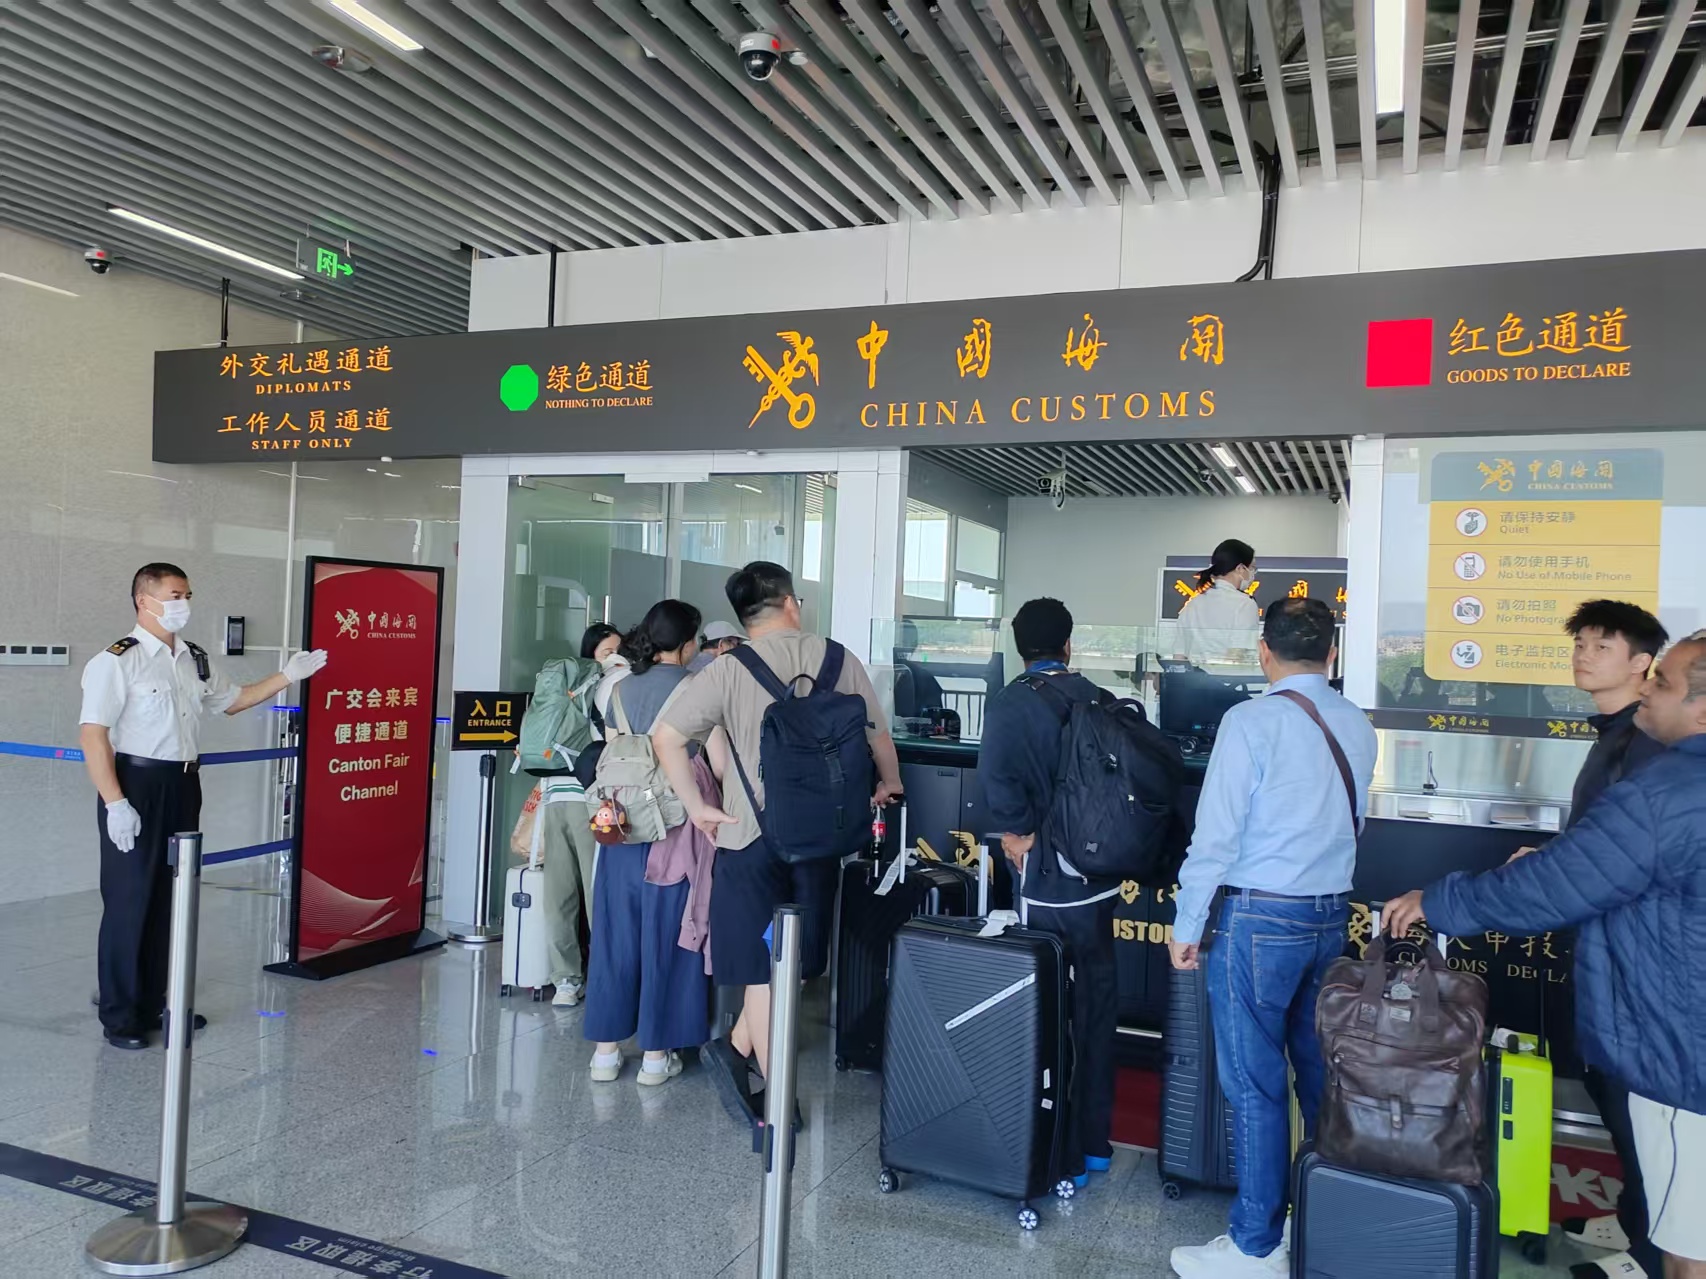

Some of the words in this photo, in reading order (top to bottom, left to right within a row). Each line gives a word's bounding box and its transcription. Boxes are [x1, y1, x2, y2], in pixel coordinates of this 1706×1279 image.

[1448, 307, 1631, 357] 红色通道
[219, 345, 393, 379] 外交礼遇通道
[546, 360, 653, 393] 绿色通道
[1447, 368, 1509, 384] GOODS
[1513, 366, 1539, 382] TO
[1543, 362, 1631, 380] DECLARE
[255, 379, 353, 395] DIPLOMATS
[545, 398, 588, 409] NOTHING
[591, 397, 605, 408] TO
[607, 396, 653, 408] DECLARE
[860, 399, 987, 429] CHINA
[1010, 390, 1216, 423] CUSTOMS
[217, 408, 392, 436] 工作人员通道
[251, 438, 303, 451] STAFF
[308, 437, 353, 450] ONLY
[1499, 511, 1576, 524] 请保持安静
[1500, 525, 1530, 535] Quiet
[1498, 555, 1590, 569] 请勿使用手机
[1497, 571, 1514, 580] No
[1516, 571, 1536, 580] Use
[1539, 571, 1550, 580] of
[1553, 571, 1593, 581] Mobile
[1595, 571, 1632, 581] Phone
[1496, 600, 1557, 612] 请勿拍照
[1496, 614, 1512, 623] No
[1514, 614, 1567, 625] Photogra
[388, 632, 417, 640] CUSTOMS
[1495, 659, 1547, 669] Electronic
[325, 687, 418, 710] 广交会来宾
[470, 699, 512, 717] 入口
[467, 719, 512, 727] ENTRANCE
[334, 720, 409, 745] 便捷通道
[328, 755, 381, 774] Canton
[384, 753, 411, 770] Fair
[341, 781, 399, 802] Channel
